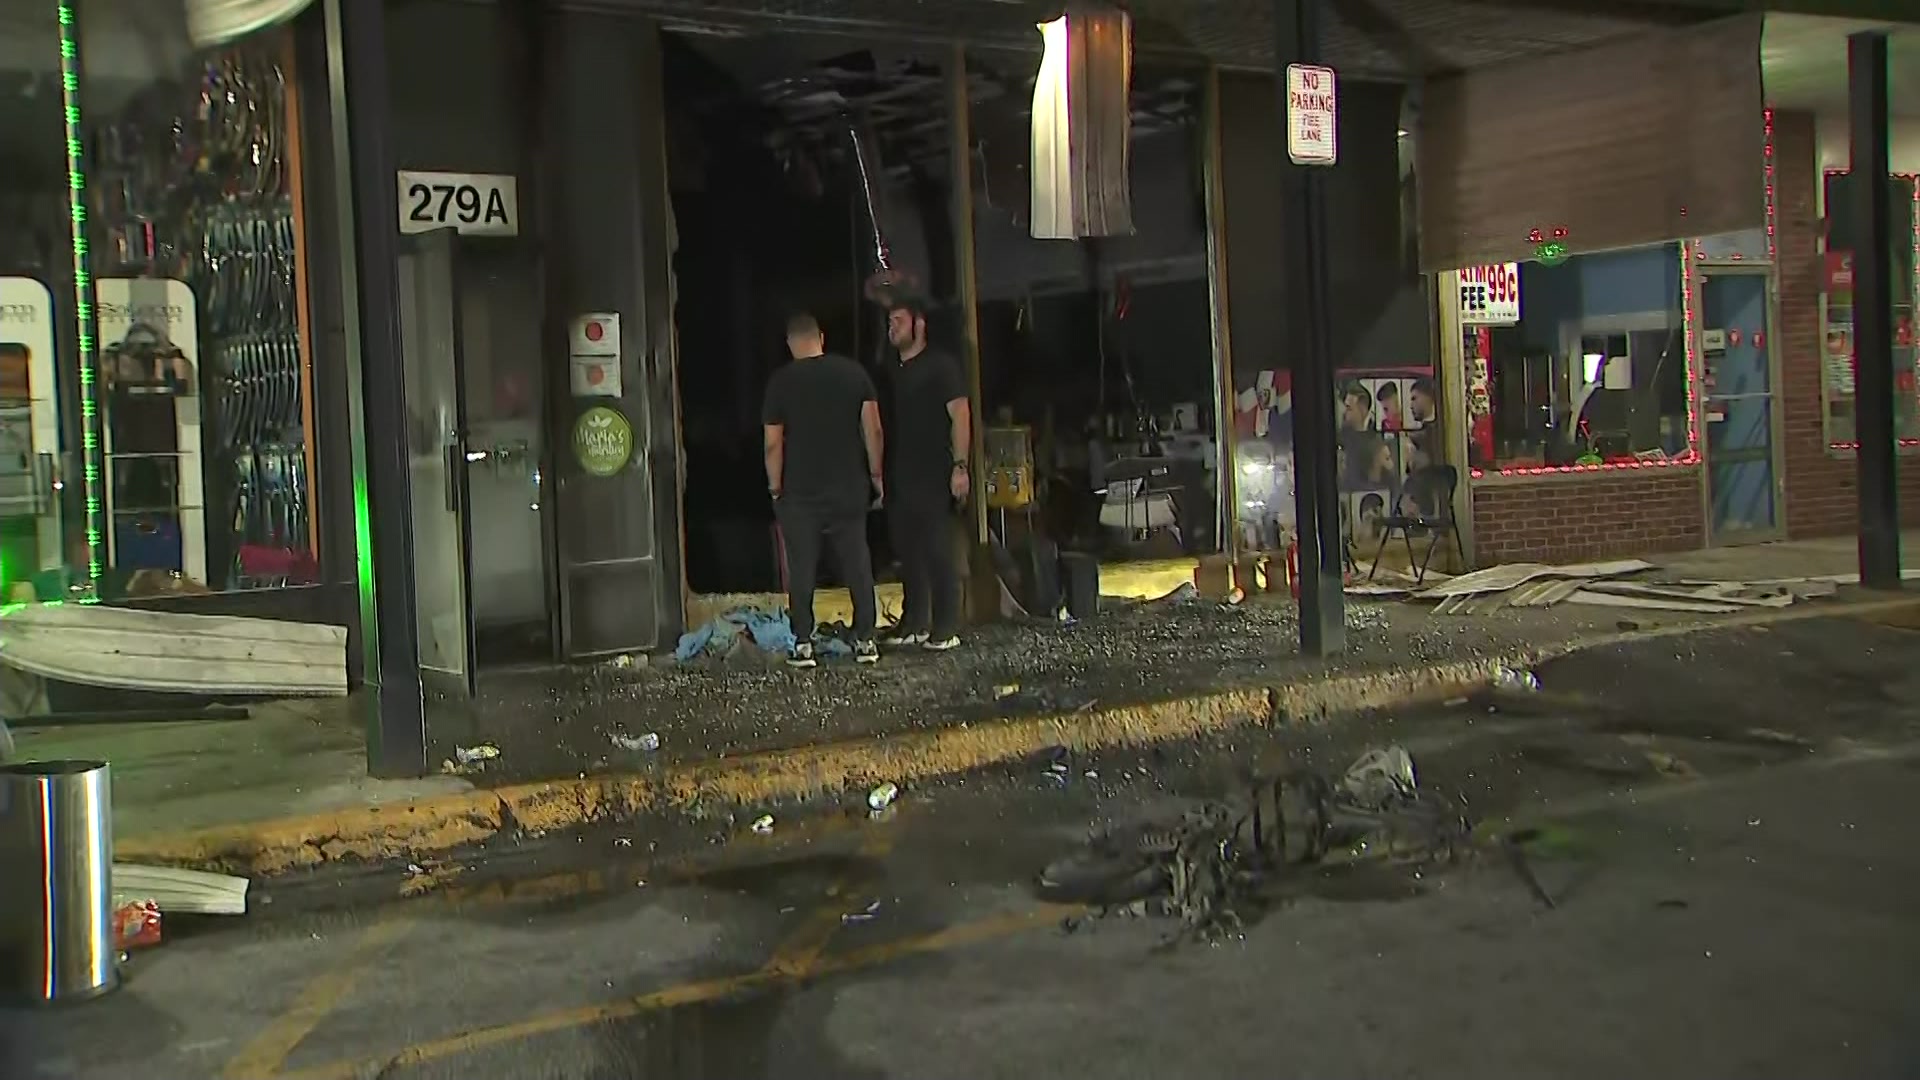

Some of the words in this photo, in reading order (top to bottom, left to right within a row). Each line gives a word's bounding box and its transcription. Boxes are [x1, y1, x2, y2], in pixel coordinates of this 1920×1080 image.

[1303, 72, 1319, 90] NO
[1291, 91, 1332, 113] PARKING
[409, 184, 508, 224] 279A
[1461, 286, 1486, 311] FEE
